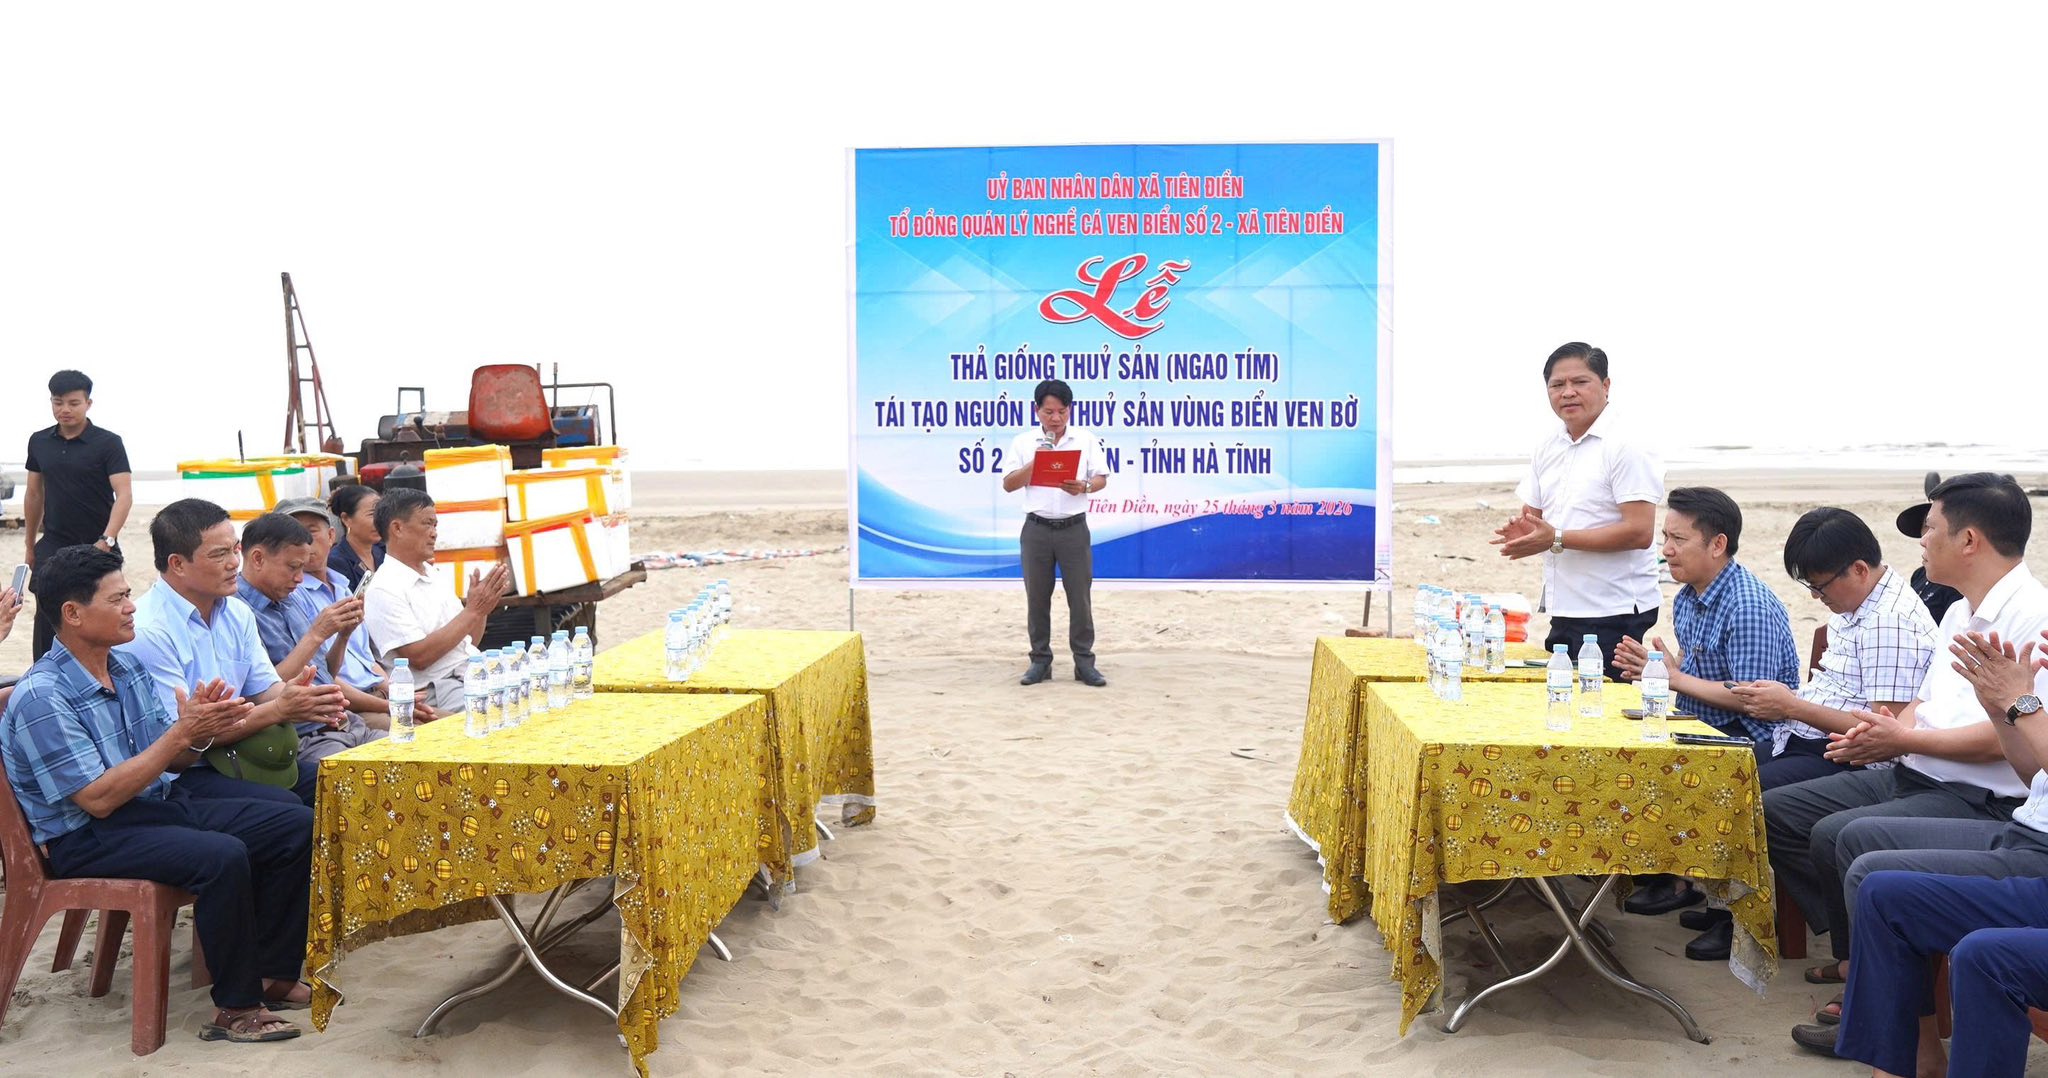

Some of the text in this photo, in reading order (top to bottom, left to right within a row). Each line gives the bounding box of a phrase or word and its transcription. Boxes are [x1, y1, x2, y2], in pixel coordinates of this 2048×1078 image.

[988, 169, 1244, 200] UỶ BAN NHÂN DÂN XÃ TIÊN ĐIỀN
[889, 207, 910, 237] TỔ
[913, 209, 958, 237] ĐỒNG
[1010, 210, 1029, 236] LÝ
[1033, 208, 1076, 235] NGHỀ
[1081, 209, 1103, 235] CÁ
[1107, 214, 1139, 235] VEN
[1143, 205, 1181, 235] BIỂN
[1185, 206, 1207, 235] SỐ
[1211, 214, 1222, 234] 2
[1238, 208, 1259, 234] XÃ
[1264, 208, 1300, 234] TIÊN
[1304, 205, 1344, 234] ĐIỀN
[1039, 253, 1192, 340] Lễ
[951, 345, 1278, 383] THẢ GIỐNG THUỶ SẢN (NGAO TÍM)
[875, 396, 905, 427] TÁI
[912, 401, 948, 432] TẠO
[956, 392, 1022, 426] NGUỒN
[1070, 391, 1117, 427] THUỶ
[1124, 392, 1163, 426] SẢN
[1171, 396, 1223, 426] VÙNG
[1232, 390, 1277, 426] BIỂN
[1285, 401, 1323, 427] VEN
[1331, 395, 1359, 427] BỜ
[959, 438, 985, 473] SỐ
[991, 447, 1003, 473] 2
[1140, 438, 1185, 474] TỈNH
[1194, 443, 1218, 473] HÀ
[1226, 443, 1270, 473] TĨNH
[1088, 499, 1117, 513] Tiên
[1164, 499, 1198, 517] ngày
[1202, 500, 1219, 513] 25
[1223, 499, 1264, 518] tháng
[1268, 500, 1278, 515] 3
[1281, 501, 1313, 516] năm
[1316, 499, 1353, 516] 2026
